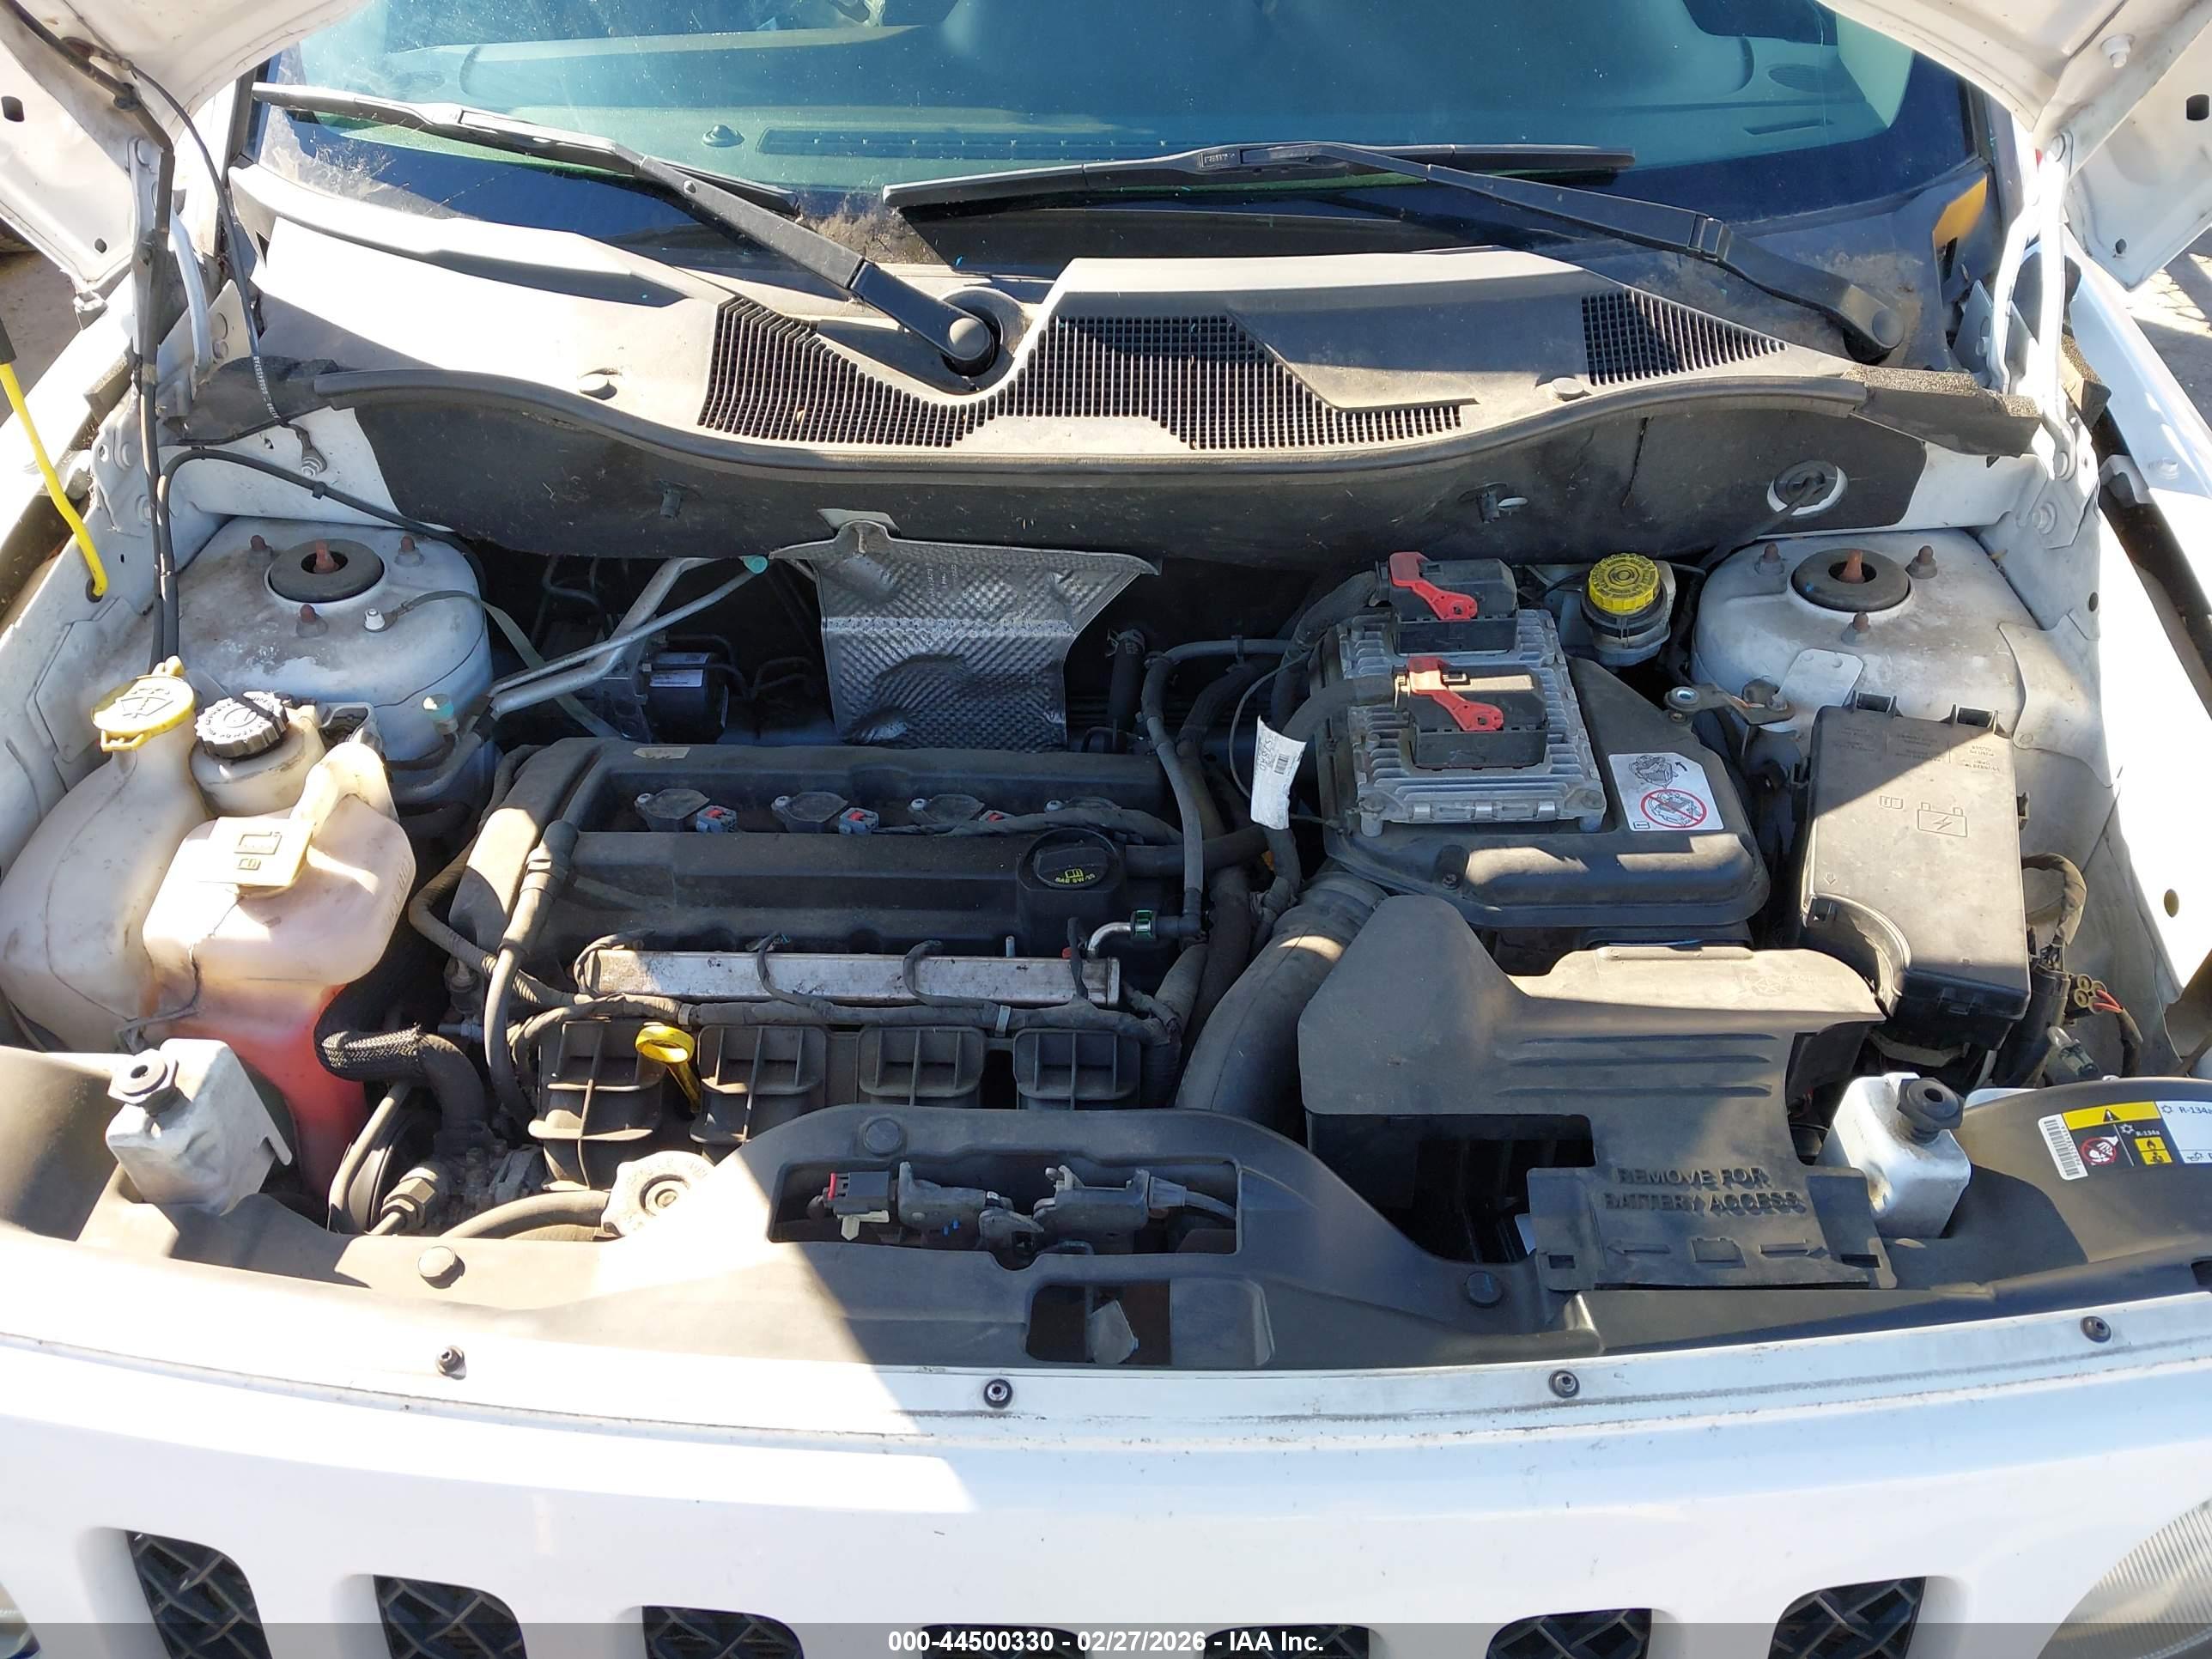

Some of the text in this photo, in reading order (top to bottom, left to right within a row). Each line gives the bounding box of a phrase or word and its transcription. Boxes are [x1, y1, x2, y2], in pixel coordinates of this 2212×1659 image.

[1617, 1167, 1767, 1188] REMOVE FOR
[1603, 1191, 1803, 1214] BATTERY ACCESS
